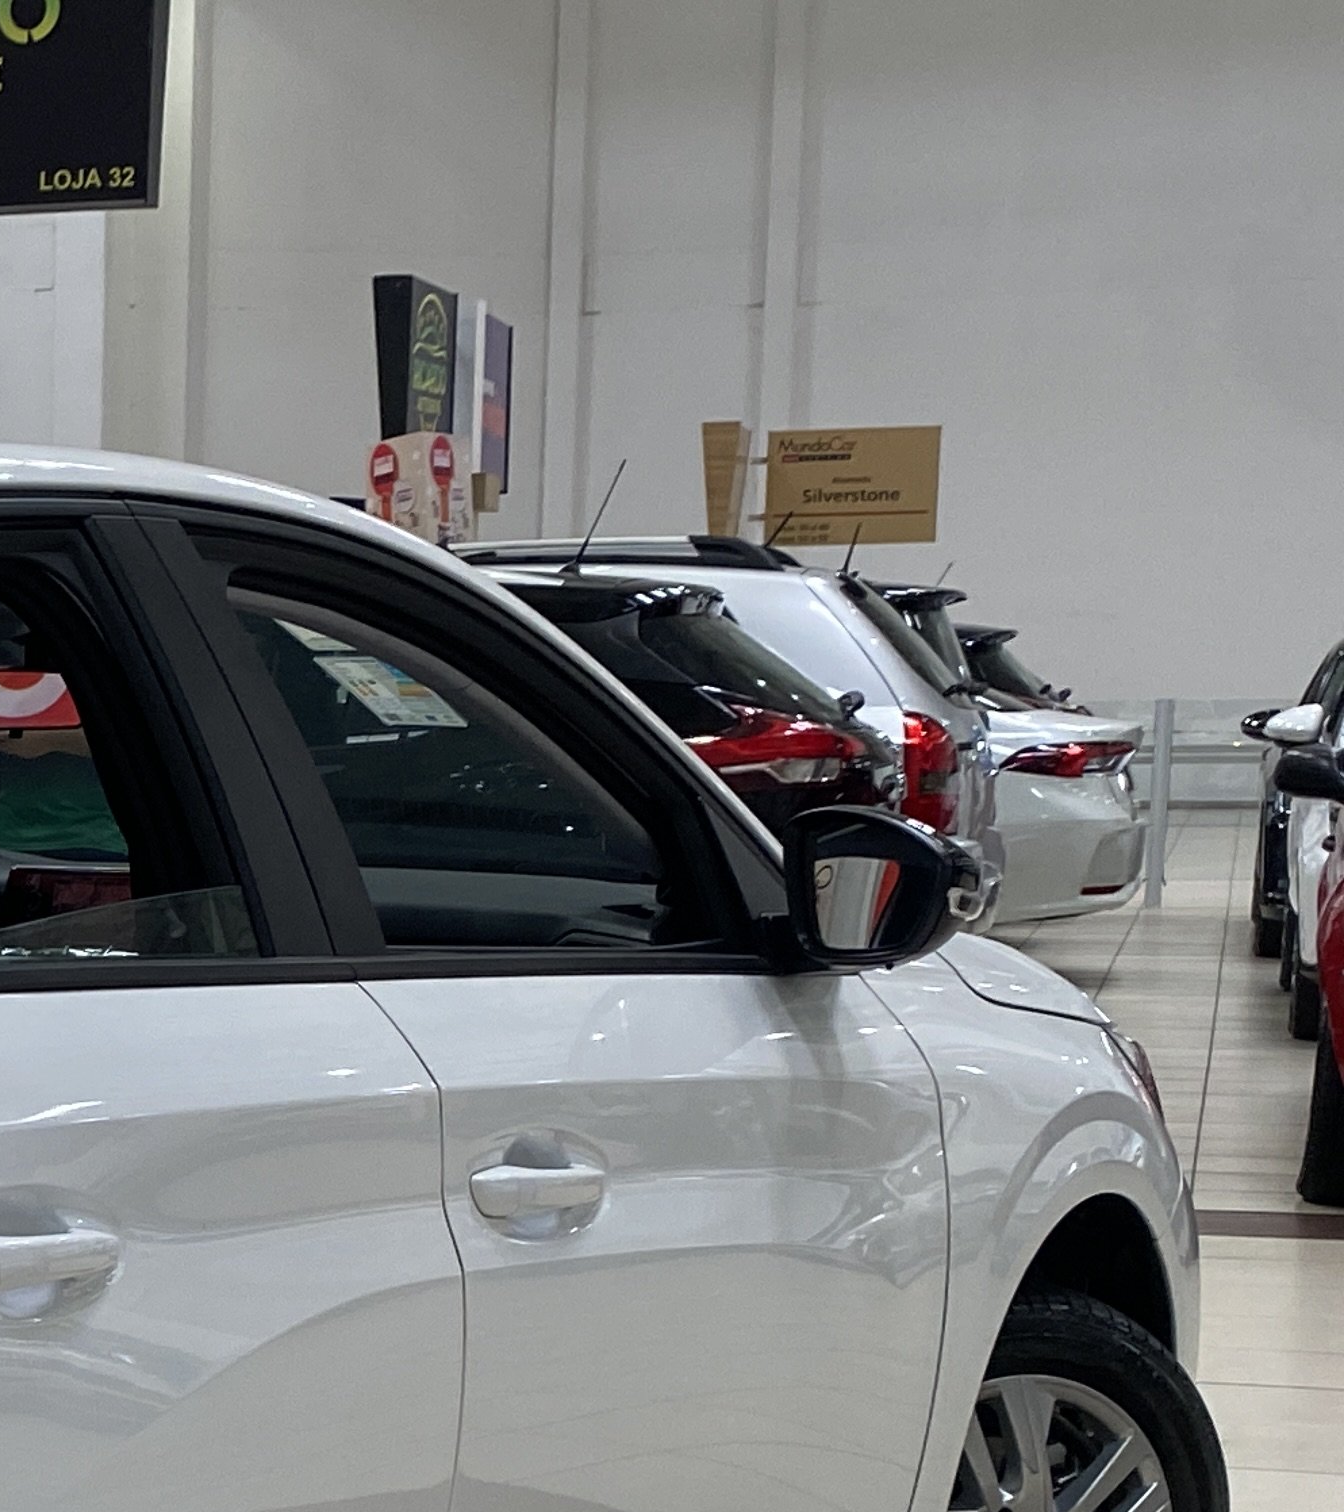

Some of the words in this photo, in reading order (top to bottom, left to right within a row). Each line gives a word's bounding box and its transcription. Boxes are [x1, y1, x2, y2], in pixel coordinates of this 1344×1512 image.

[39, 168, 102, 191] LOJA
[108, 166, 135, 188] 32
[802, 488, 902, 504] Silverstone
